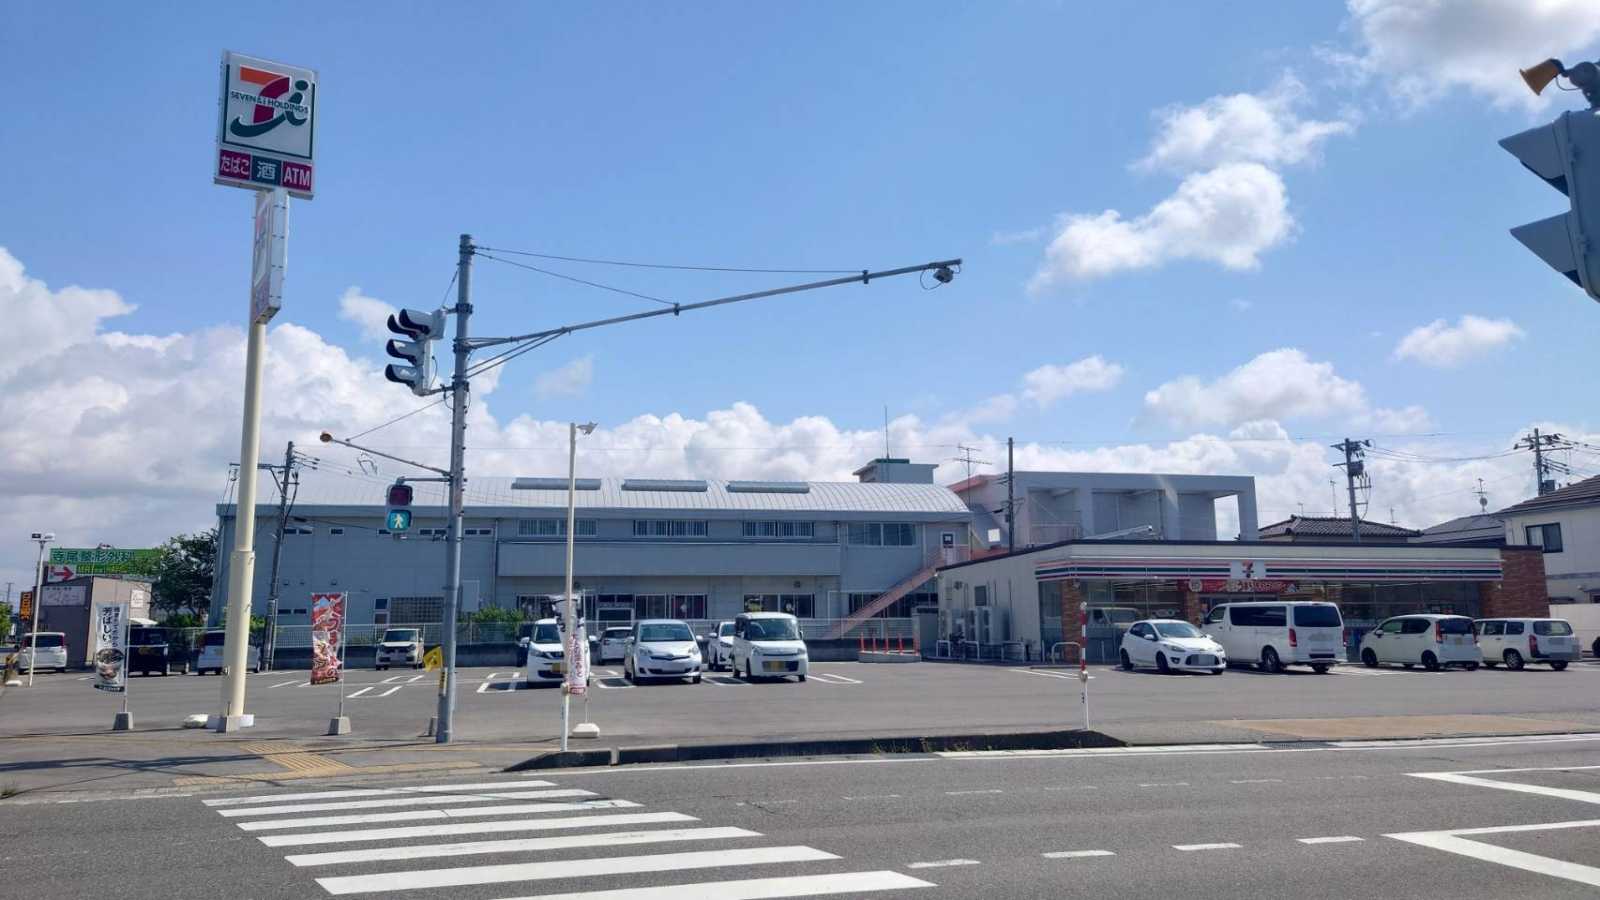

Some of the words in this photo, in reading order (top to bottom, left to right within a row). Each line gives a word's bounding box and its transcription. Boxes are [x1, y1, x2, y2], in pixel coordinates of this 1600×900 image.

[268, 99, 309, 114] HOLDINGS
[221, 156, 250, 176] たばこ
[257, 160, 278, 180] 酒
[283, 166, 311, 187] ATM
